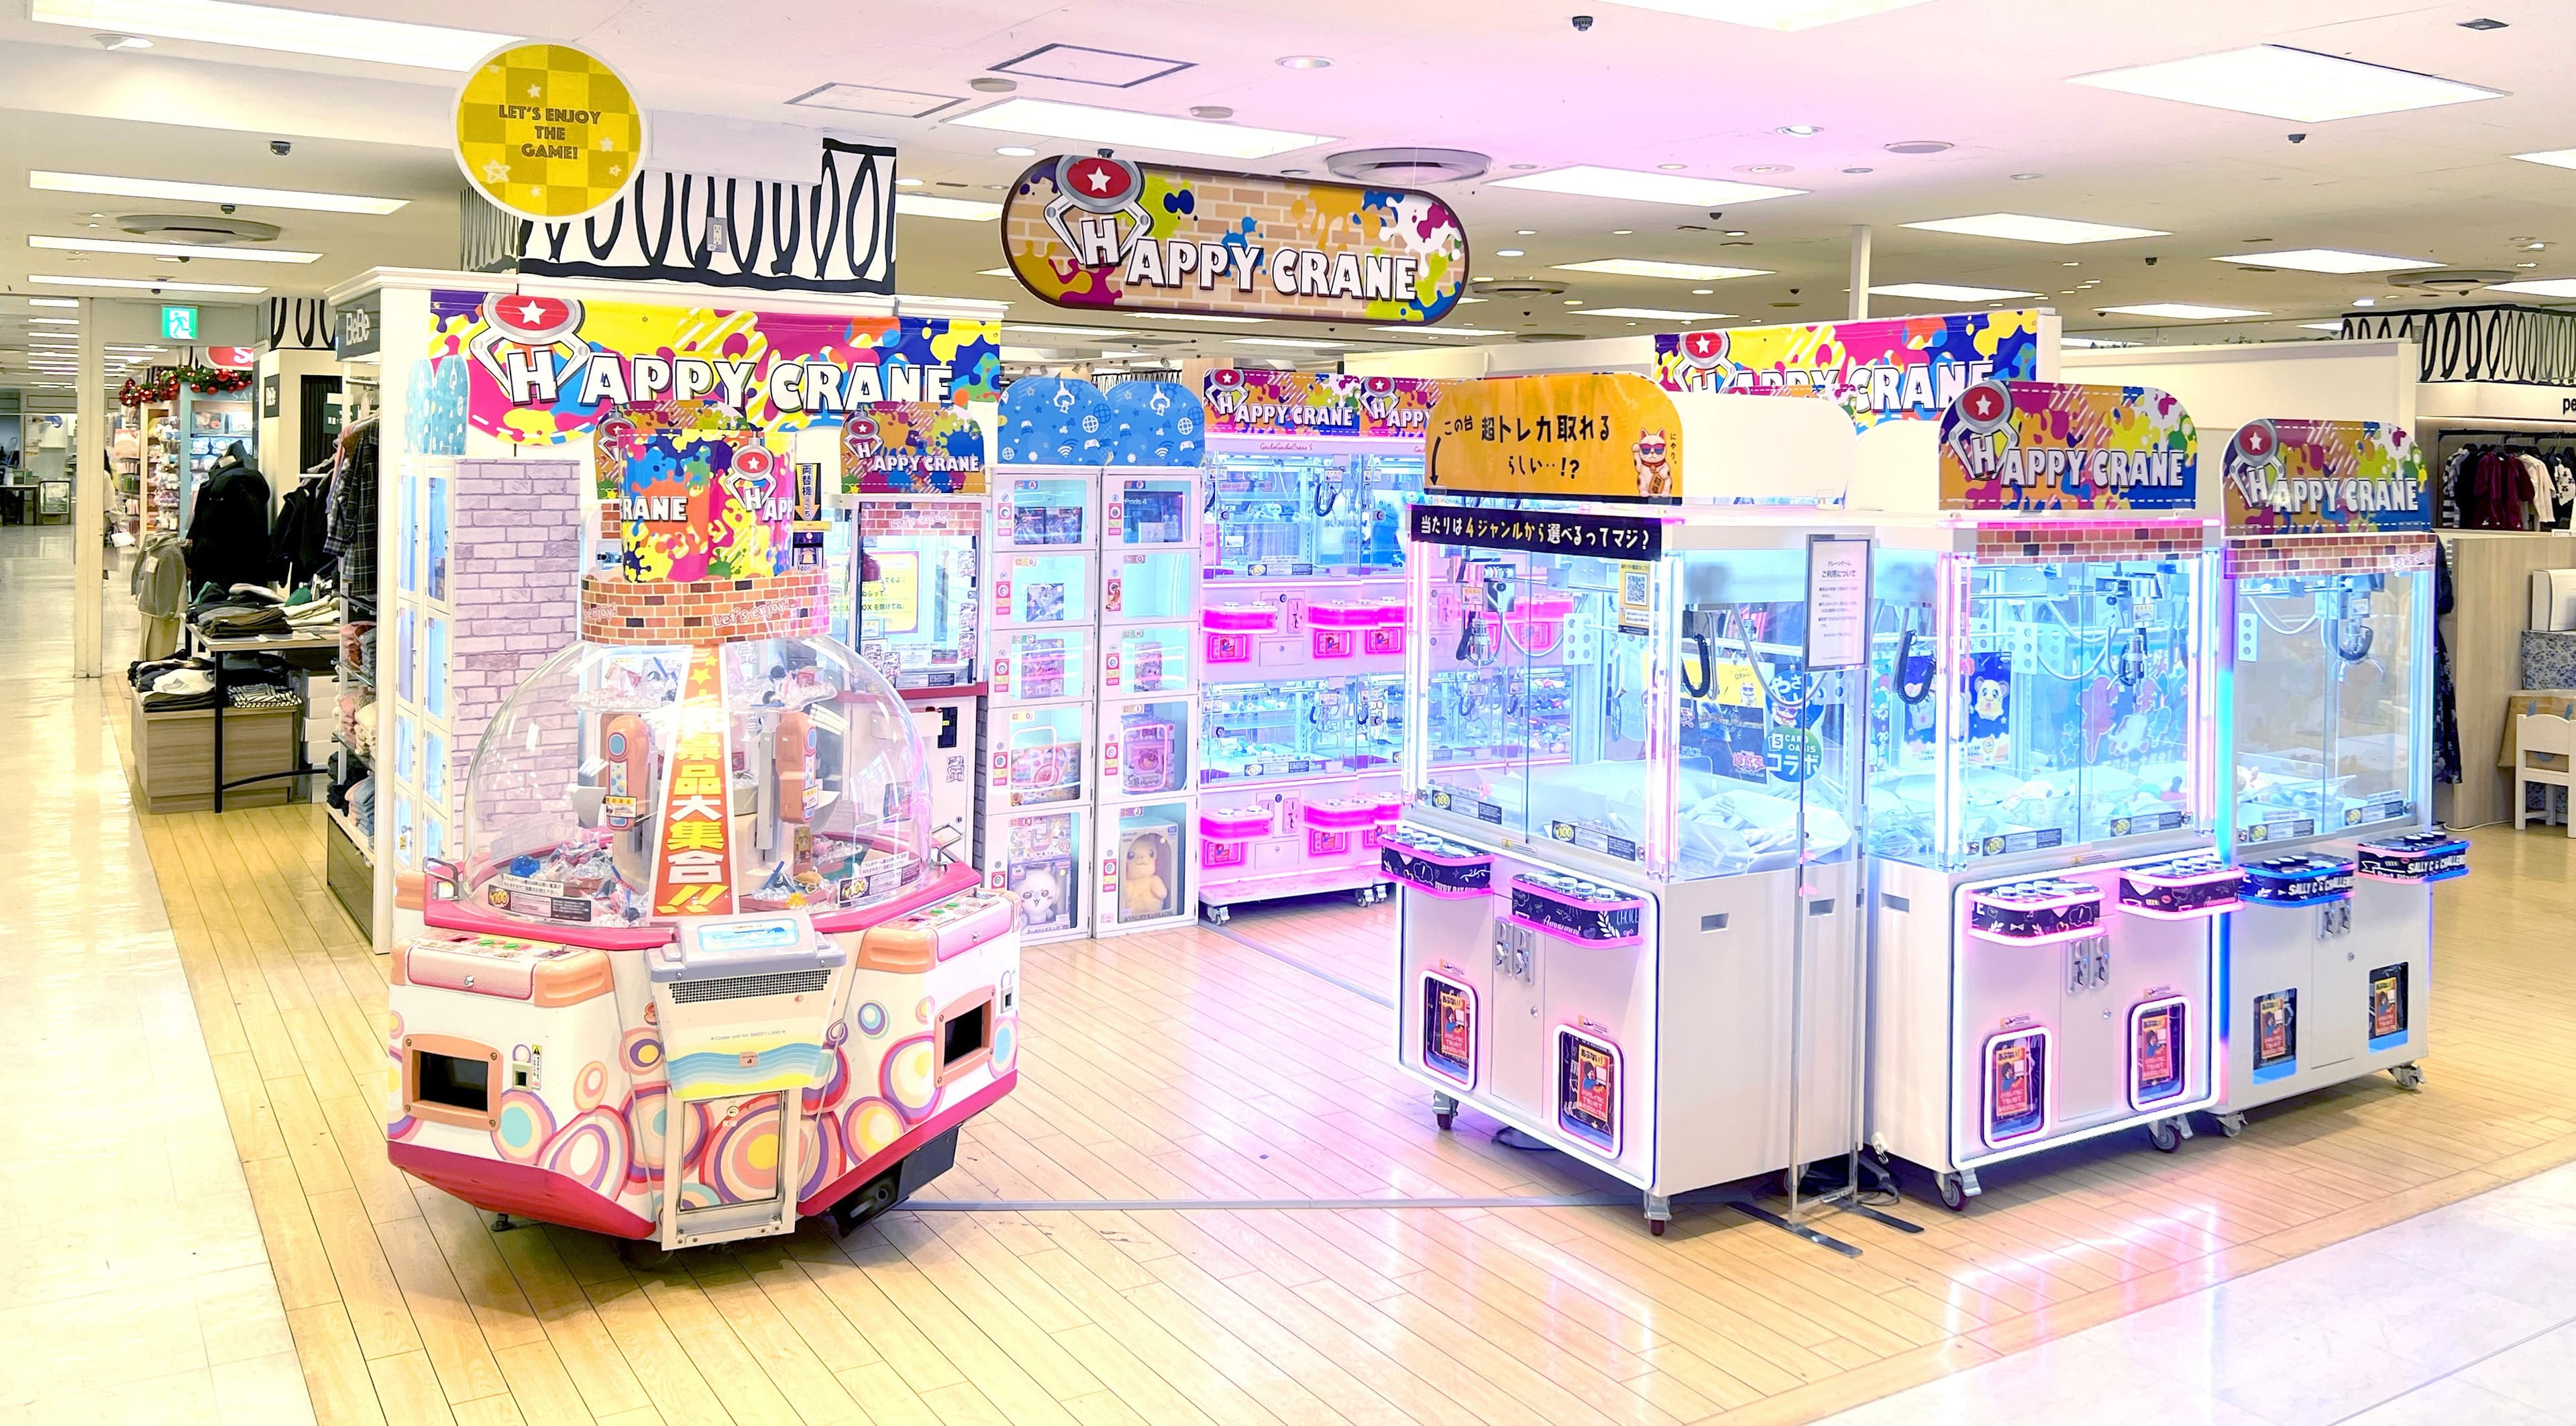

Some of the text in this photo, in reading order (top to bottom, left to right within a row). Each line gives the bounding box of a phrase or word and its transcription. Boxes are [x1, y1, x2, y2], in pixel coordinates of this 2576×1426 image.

[499, 105, 601, 125] LET'S ENJOY
[535, 125, 566, 140] THE
[521, 144, 578, 160] GAME!
[1079, 217, 1419, 301] HAPPY CRANE
[506, 349, 953, 413] HAPPY CRANE
[1218, 395, 1353, 427] HAPPY CRANE
[1444, 415, 1610, 443] この台 超トレカ取れる
[857, 442, 981, 472] HAPPY CRANE
[1971, 434, 2185, 488] HAPPY CRANE
[2247, 466, 2418, 512] HAPPY CRANE
[621, 495, 688, 523] RANE
[918, 511, 952, 527] enjoy!
[1821, 570, 1856, 578] ご利用について
[712, 597, 790, 627] Let's enjoy!
[1788, 744, 1816, 753] OAIS
[1766, 753, 1819, 776] コラボ
